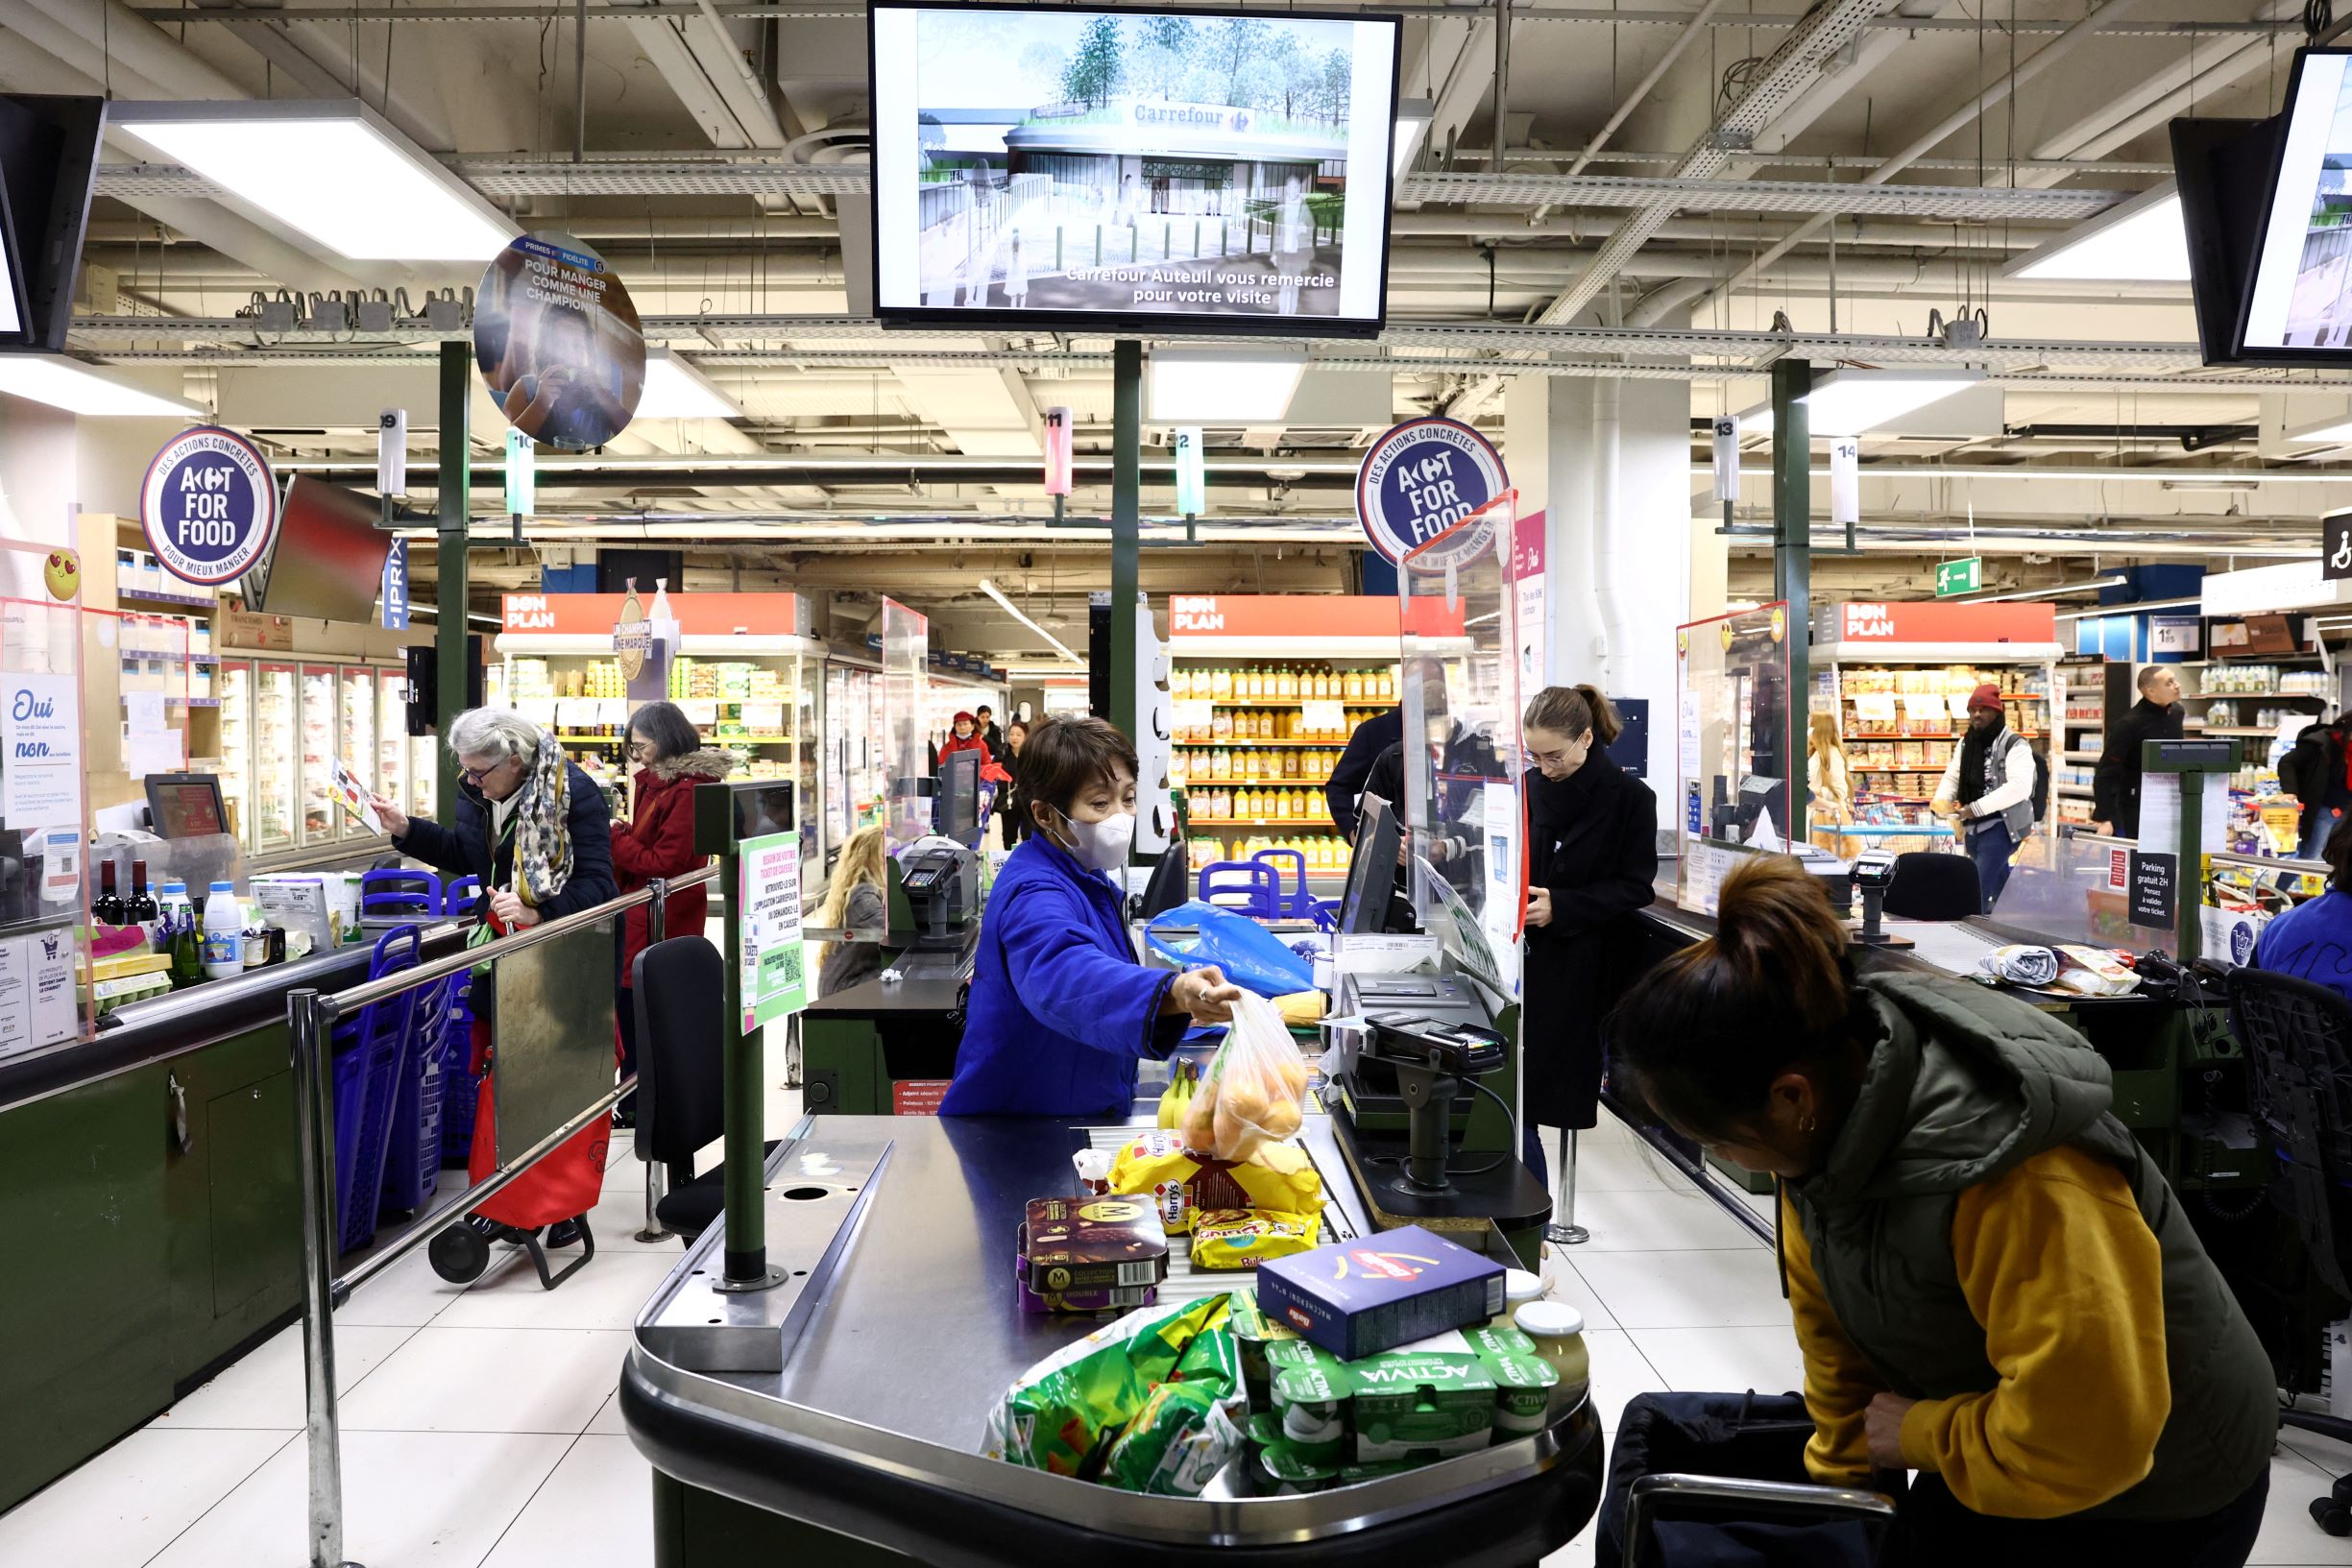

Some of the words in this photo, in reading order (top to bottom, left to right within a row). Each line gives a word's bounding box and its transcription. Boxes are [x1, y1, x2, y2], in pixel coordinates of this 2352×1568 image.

[1134, 105, 1224, 125] Carrefour
[525, 241, 551, 255] PRIMES
[524, 259, 558, 277] POUR
[560, 270, 607, 292] MANGER
[1066, 266, 1147, 284] Carrefour
[1152, 267, 1212, 285] Auteuil
[1217, 273, 1256, 286] vous
[1260, 269, 1335, 288] remercie
[532, 276, 576, 295] COMME
[578, 287, 601, 303] UNE
[1133, 289, 1174, 304] pour
[1178, 289, 1222, 303] votre
[1226, 288, 1272, 304] visite
[1048, 413, 1062, 427] 11
[1715, 422, 1734, 436] 13
[158, 456, 174, 476] DES
[174, 437, 209, 463] ACTIONS
[212, 437, 258, 477] CONCRÈTES
[1369, 461, 1385, 485] DES
[1380, 431, 1417, 464] ACTIONS
[1418, 427, 1476, 453] CONCRÈTES
[1837, 445, 1855, 458] 14
[185, 494, 228, 519] FOR
[1409, 480, 1461, 517] FOR
[178, 520, 236, 545] FOOD
[163, 544, 183, 568] POUR
[186, 562, 213, 576] MIEUX
[216, 546, 250, 573] MANGER
[507, 595, 546, 612] BON
[1174, 597, 1216, 613] BON
[1848, 604, 1886, 619] BON
[507, 612, 554, 628] PLAN
[1175, 614, 1224, 630] PLAN
[1848, 620, 1894, 636] PLAN
[12, 688, 54, 721] Oui
[15, 742, 50, 758] non
[2141, 861, 2166, 875] Parking
[2137, 875, 2158, 886] gratuit
[2159, 878, 2169, 887] 2H
[2144, 886, 2161, 897] Pensez
[2146, 897, 2163, 906] valider
[2138, 905, 2151, 914] votre
[2151, 907, 2167, 917] ticket.
[1102, 1206, 1131, 1218] M
[1053, 1272, 1065, 1283] M
[1360, 1364, 1469, 1384] ACTIVIA
